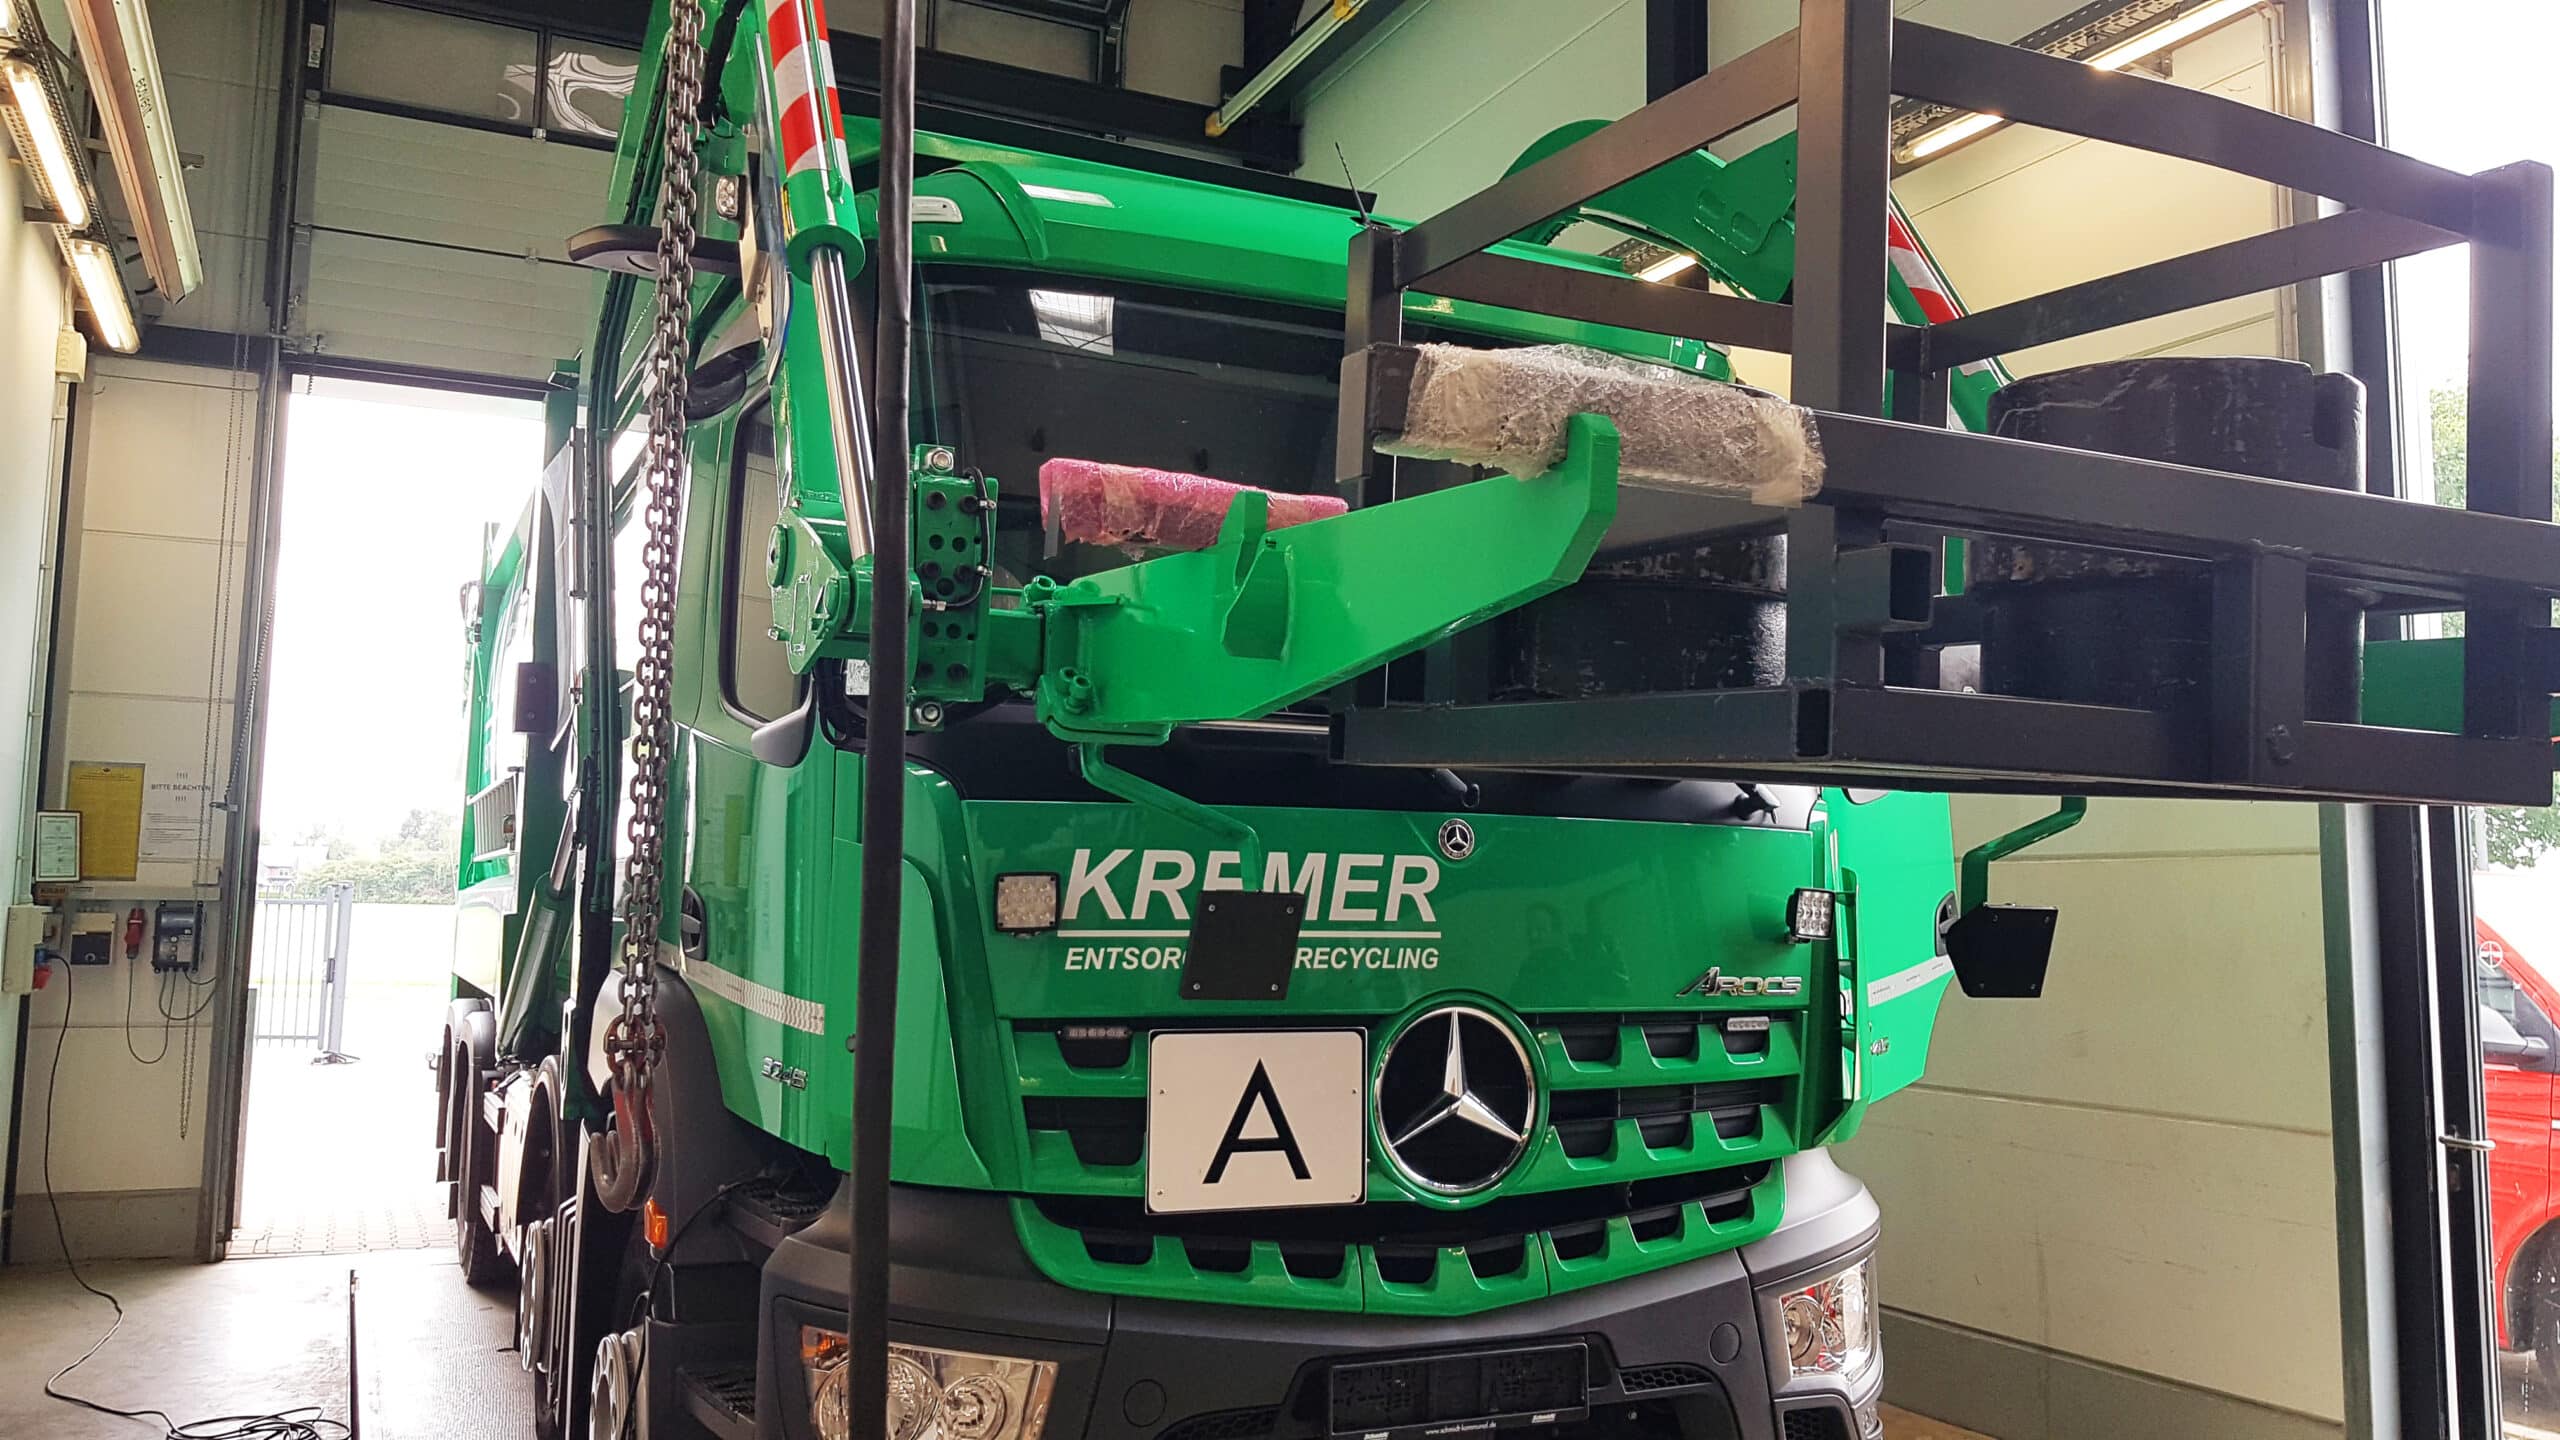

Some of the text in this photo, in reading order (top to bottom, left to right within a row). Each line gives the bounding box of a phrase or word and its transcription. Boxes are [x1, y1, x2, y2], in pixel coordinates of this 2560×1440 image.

[1064, 947, 1440, 970] ENTSOR RECYCLING
[1202, 1057, 1312, 1185] A
